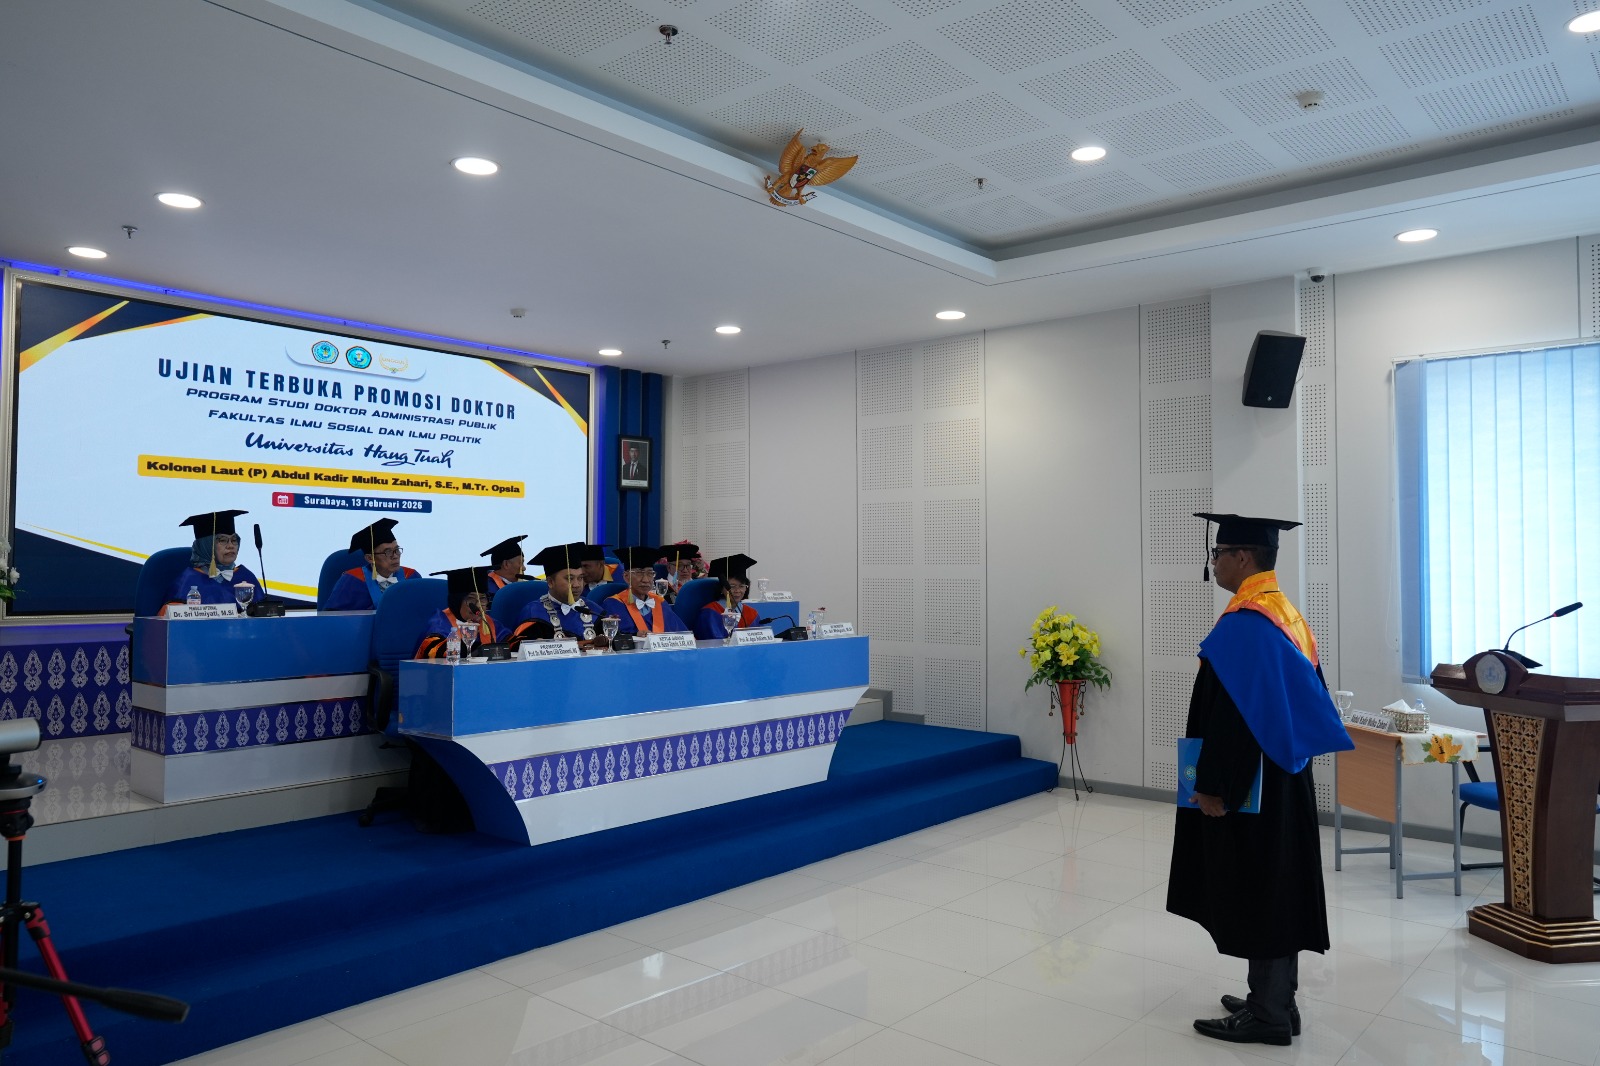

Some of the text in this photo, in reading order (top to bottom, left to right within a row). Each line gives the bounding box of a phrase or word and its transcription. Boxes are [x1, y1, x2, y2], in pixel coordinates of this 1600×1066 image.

[158, 358, 515, 420] UJIAN TERBUKA PROMOSI DOKTOR
[186, 388, 497, 430] PROGRAM STUDI DOKTOR ADMINISTRASI PUBLIK
[208, 410, 482, 444] FAKULTAS ILMU SOSIAL DAN ILMU POLITIK
[245, 432, 454, 468] Universitas Hang Tuah
[146, 461, 206, 474] Kolonel
[211, 466, 244, 476] Laut
[248, 468, 267, 478] (P)
[271, 470, 310, 480] Abdul
[314, 473, 348, 482] Kadir
[352, 476, 388, 486] Mulku
[392, 478, 432, 489] Zahari,
[435, 480, 459, 490] S.E.,
[462, 482, 488, 492] M.Tr.
[304, 496, 422, 510] Surabaya, 13 Februari 2026
